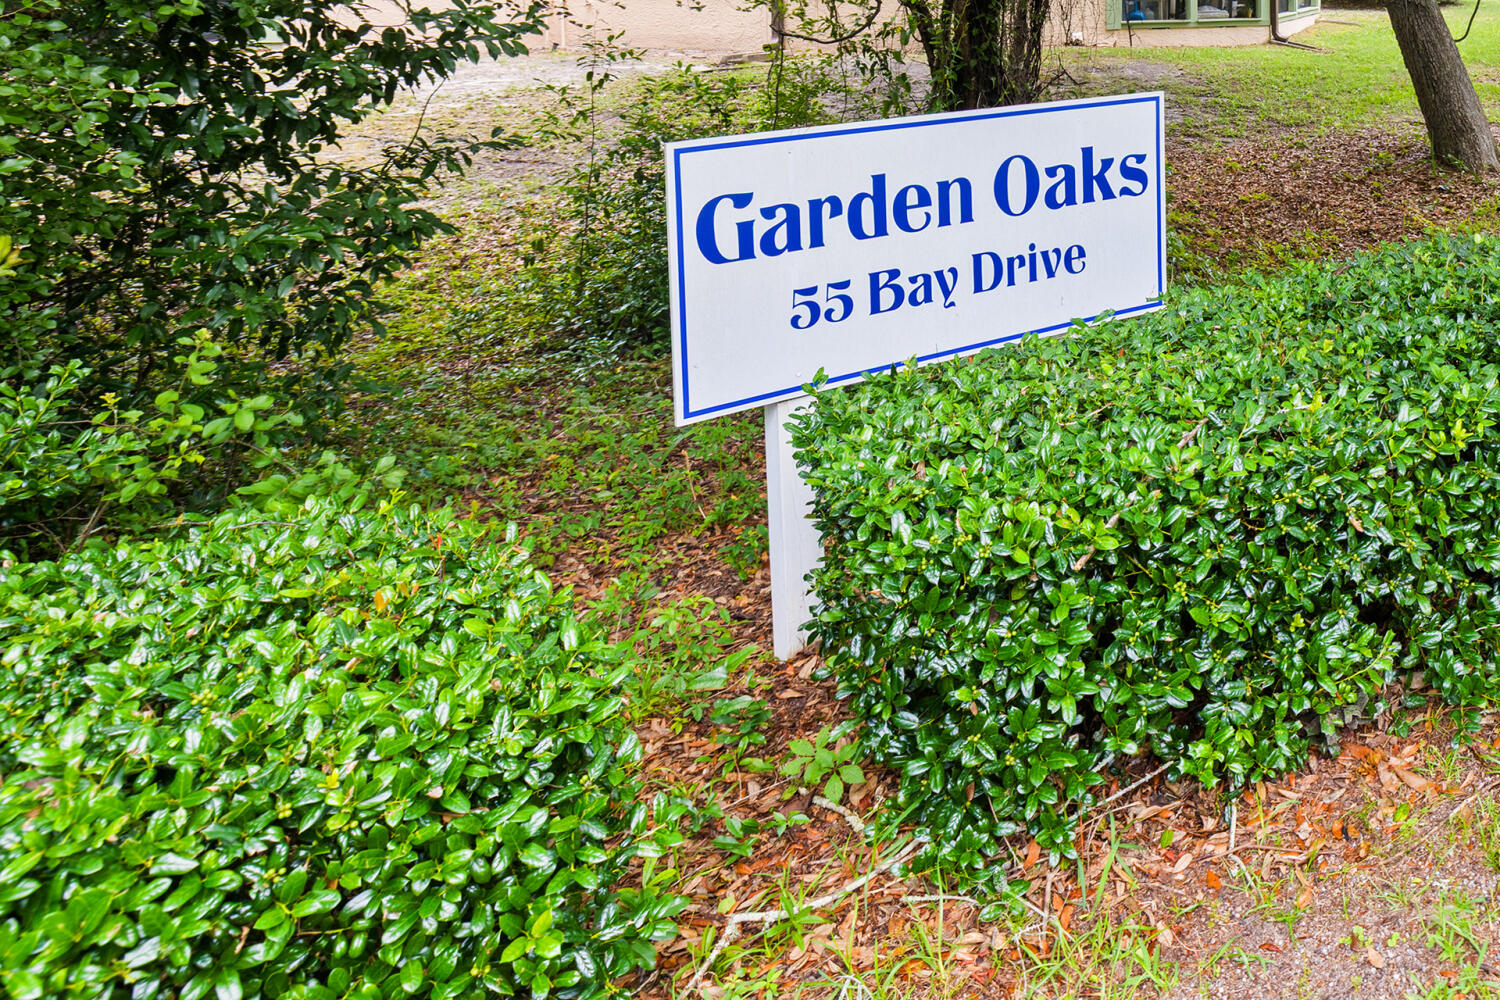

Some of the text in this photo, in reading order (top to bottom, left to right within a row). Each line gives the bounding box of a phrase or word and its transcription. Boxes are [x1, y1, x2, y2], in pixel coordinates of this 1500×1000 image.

[695, 145, 1149, 265] Garden Oaks
[789, 242, 1087, 330] 55 Bay Drive
